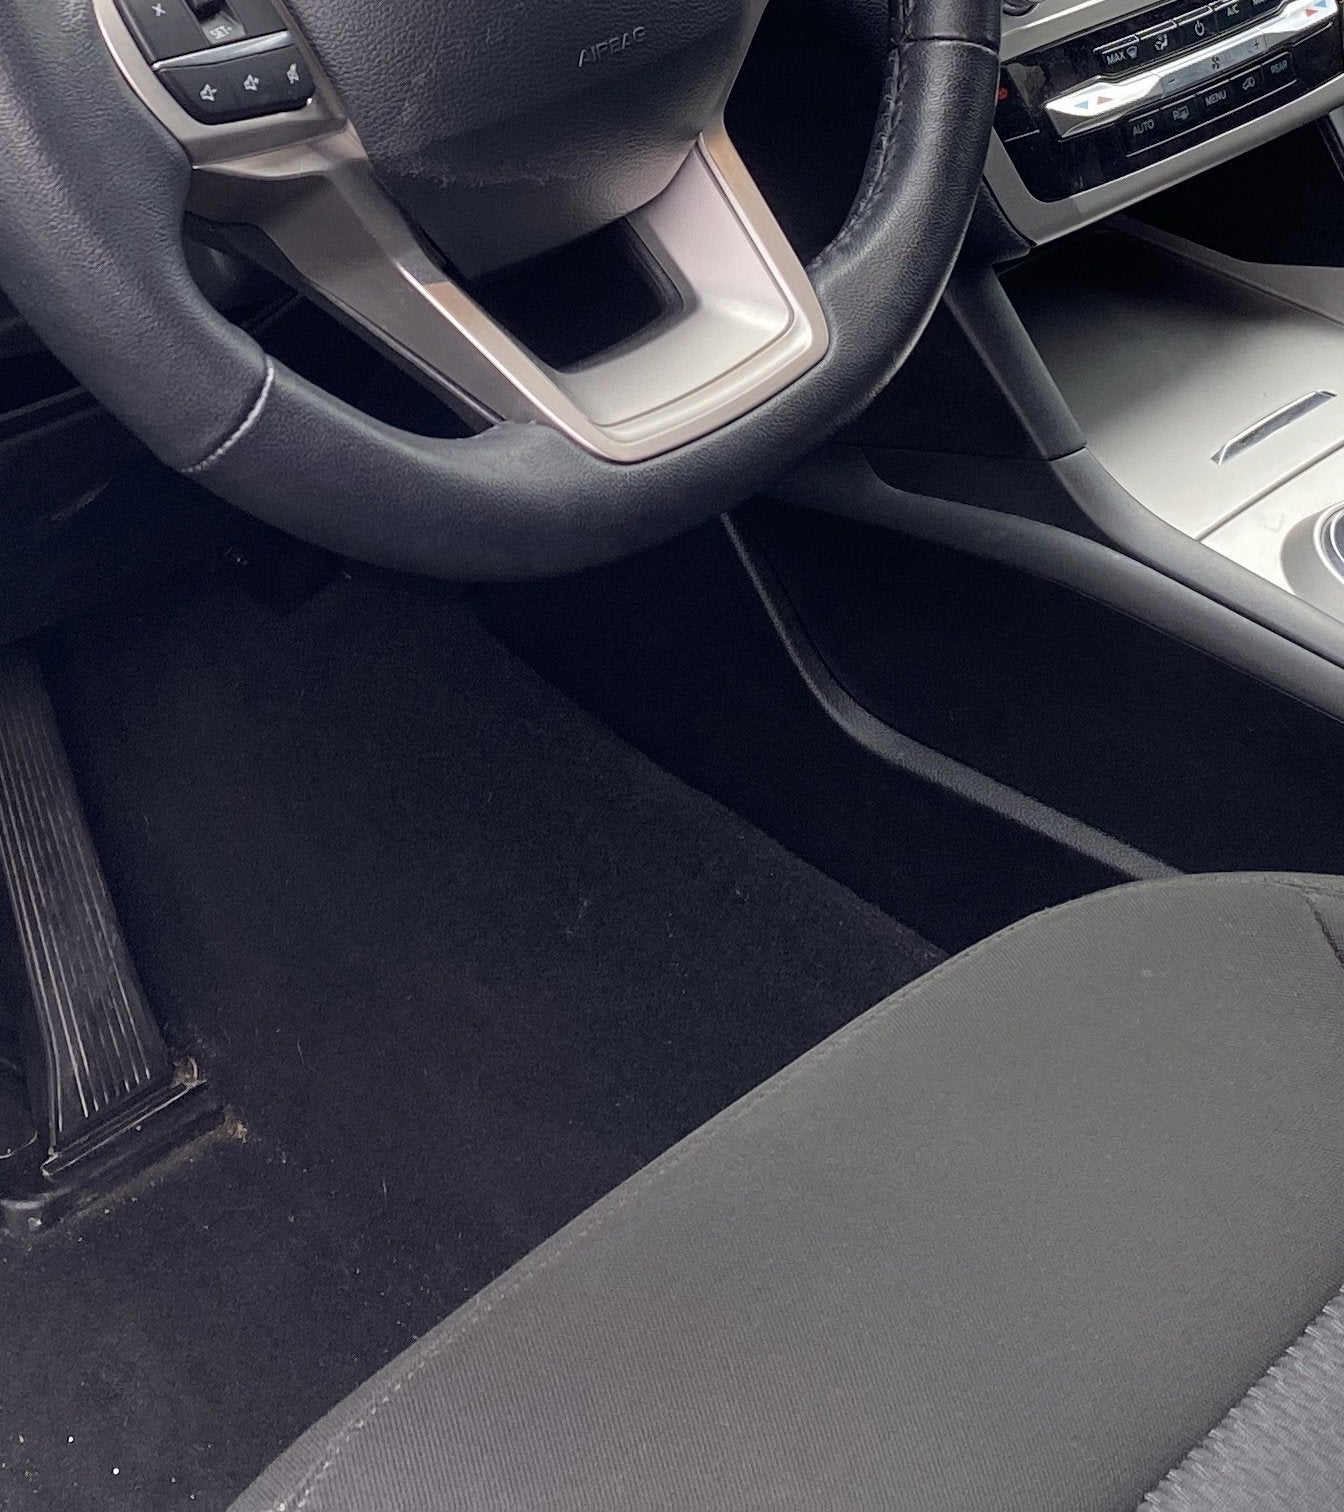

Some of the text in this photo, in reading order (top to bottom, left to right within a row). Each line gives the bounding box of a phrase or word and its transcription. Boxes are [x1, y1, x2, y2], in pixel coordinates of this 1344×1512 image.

[1106, 50, 1125, 66] MAX
[1270, 59, 1288, 75] REAR
[1205, 89, 1227, 106] MENU
[1132, 118, 1155, 137] AUTO
